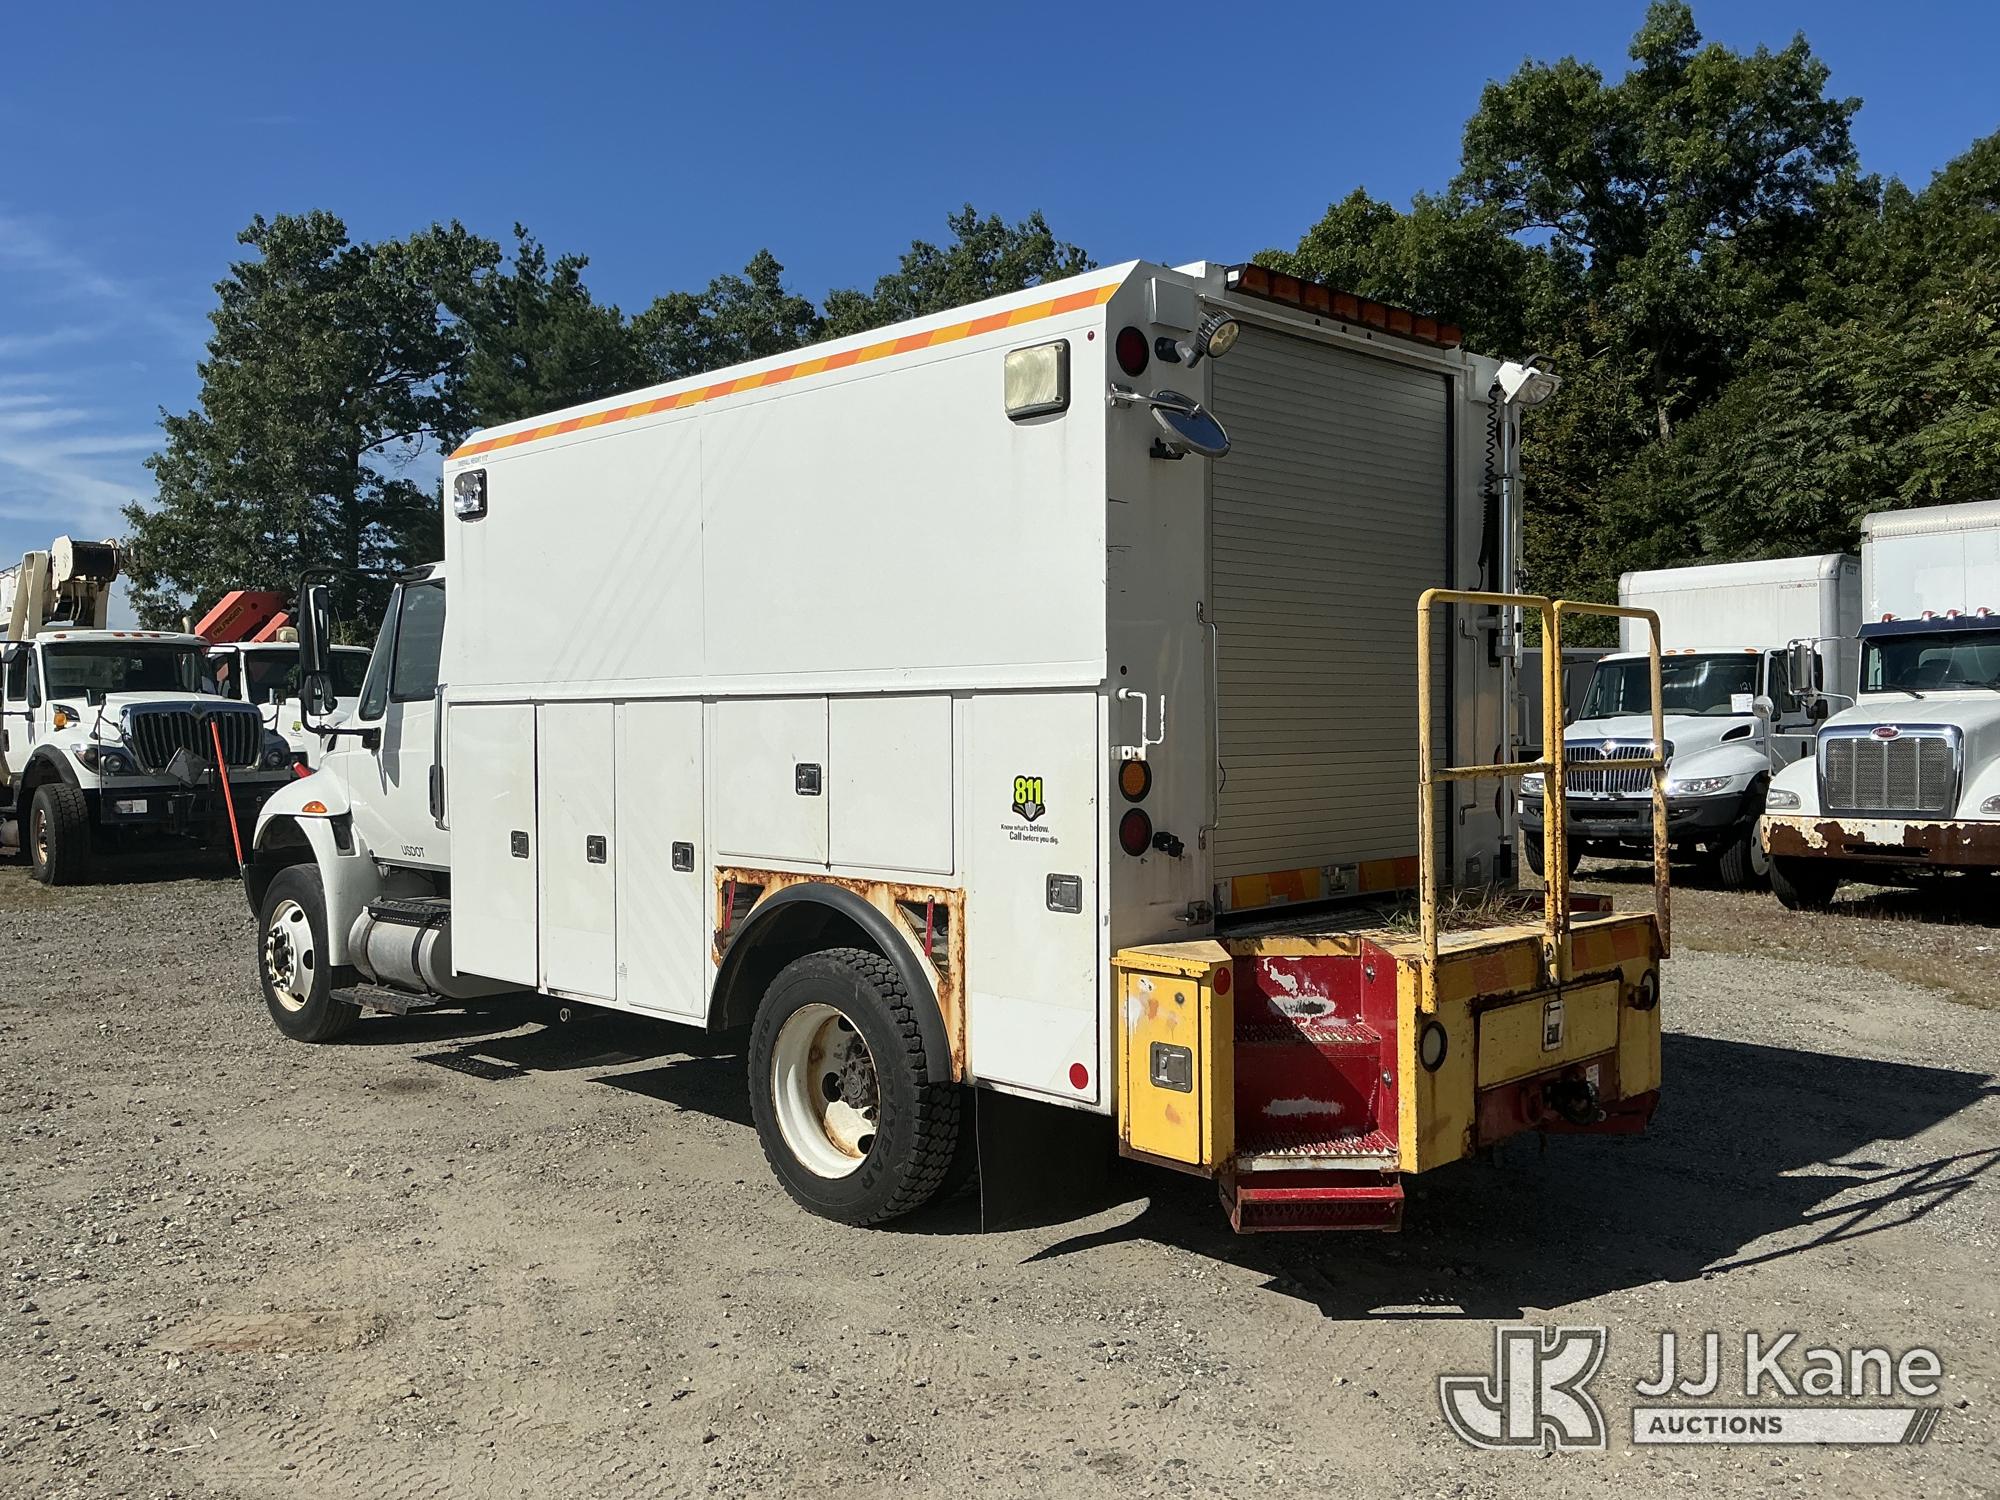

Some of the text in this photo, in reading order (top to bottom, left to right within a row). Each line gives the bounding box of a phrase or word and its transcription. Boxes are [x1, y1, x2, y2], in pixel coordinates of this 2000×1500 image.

[1014, 775, 1043, 805] 811
[1029, 824, 1049, 833] below.
[1009, 831, 1022, 840] Call
[1022, 834, 1039, 842] before
[1040, 836, 1049, 844] you
[401, 844, 425, 857] USDOT
